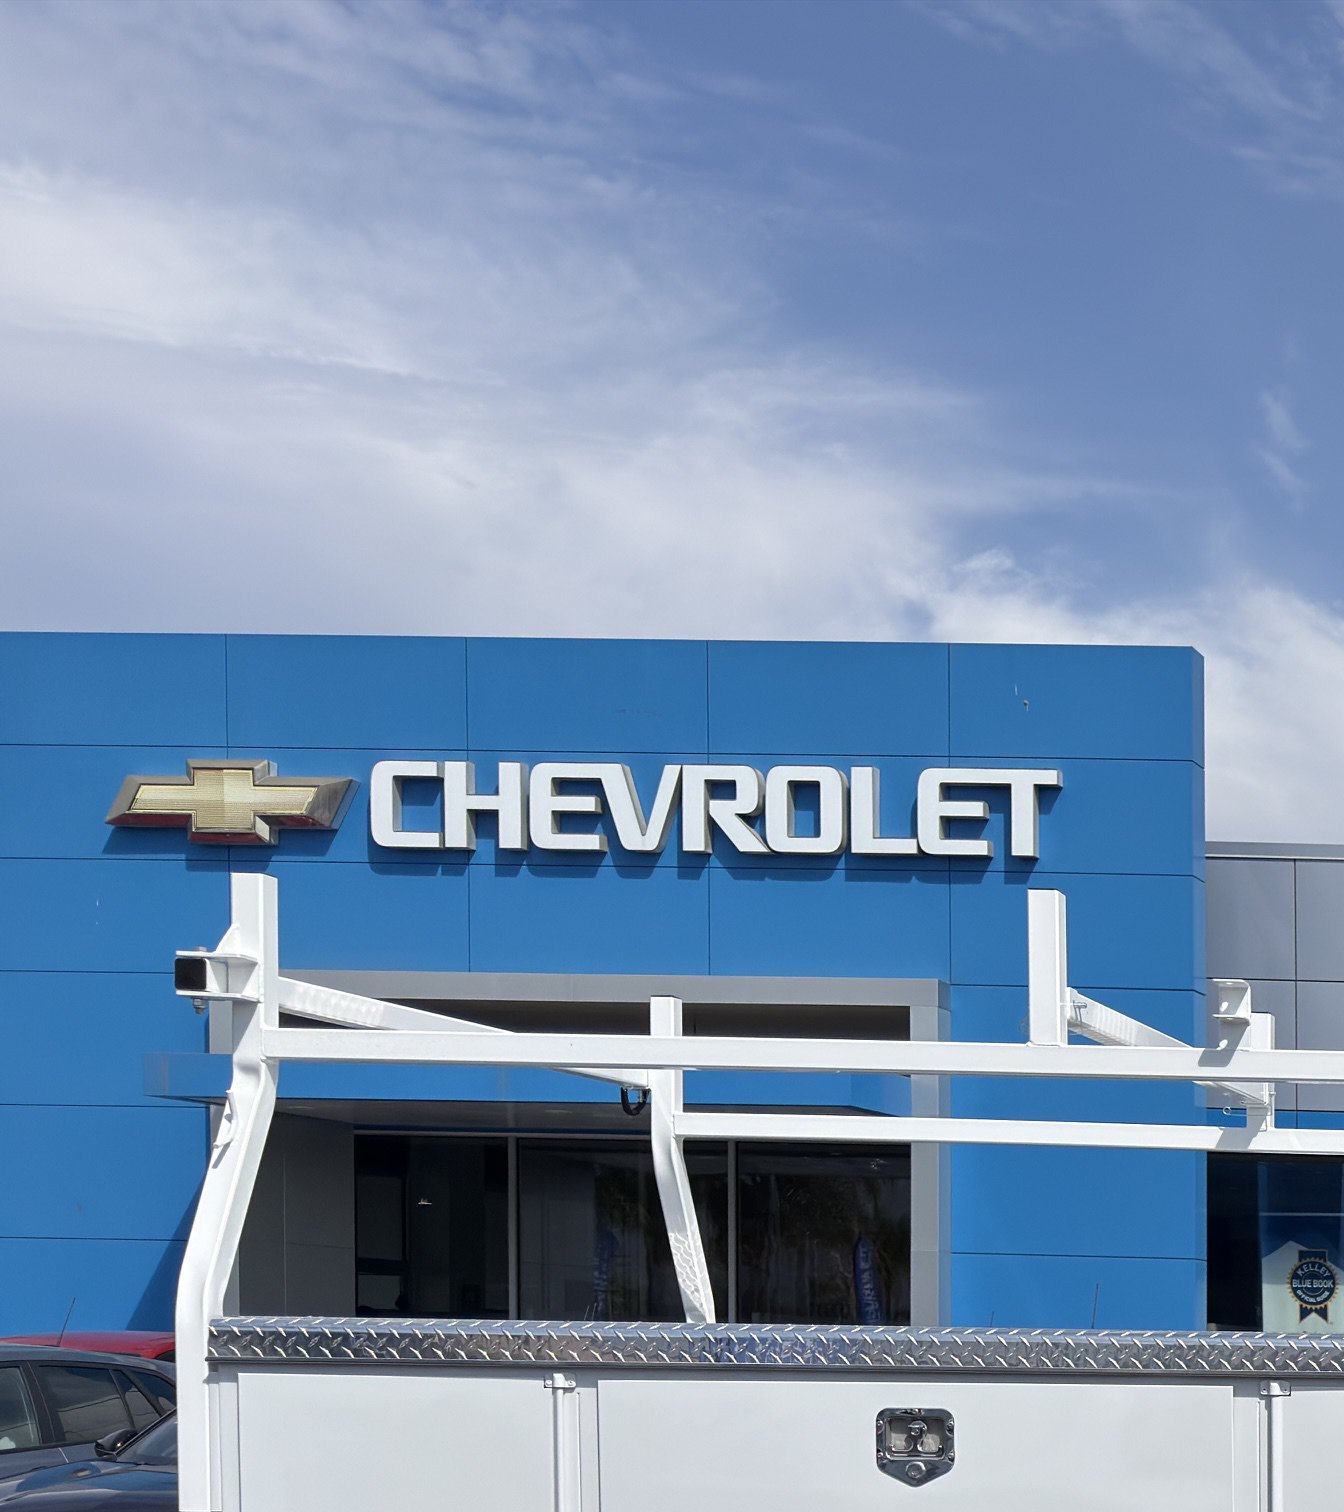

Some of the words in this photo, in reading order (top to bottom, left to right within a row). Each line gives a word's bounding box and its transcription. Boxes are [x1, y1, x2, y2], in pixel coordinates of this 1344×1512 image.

[370, 760, 1063, 859] CHEVROLET
[1296, 1263, 1331, 1277] KELLEY
[1292, 1279, 1312, 1288] BLUE
[1312, 1279, 1334, 1288] BOOK
